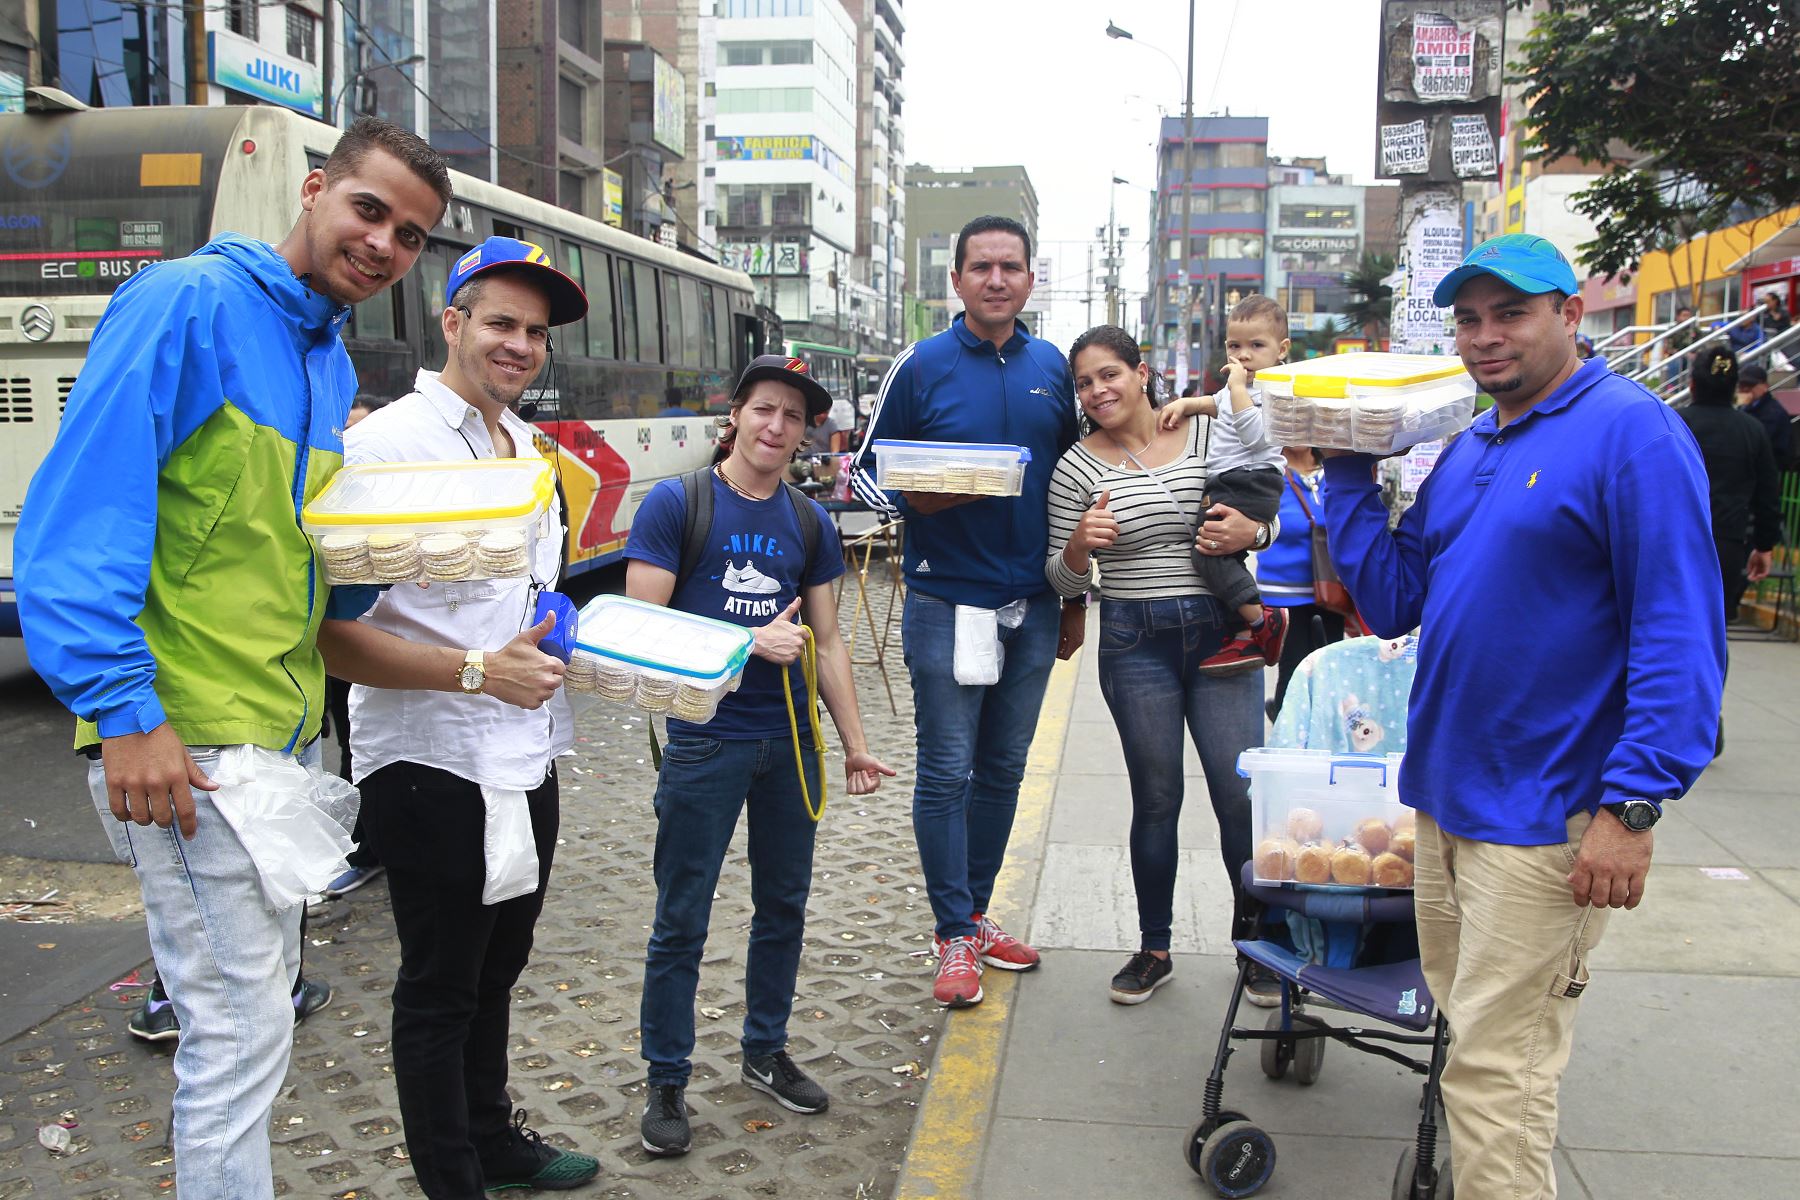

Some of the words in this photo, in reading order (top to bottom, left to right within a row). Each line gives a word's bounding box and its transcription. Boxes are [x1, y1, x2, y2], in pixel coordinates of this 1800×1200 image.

[1416, 43, 1471, 54] AMOR
[246, 58, 300, 94] JUKI
[1383, 134, 1425, 148] URGENTE
[1293, 238, 1356, 250] CORTINAS
[100, 260, 132, 277] BUS
[1407, 310, 1443, 322] LOCAL
[730, 533, 777, 557] NIKE
[723, 595, 779, 617] ATTACK
